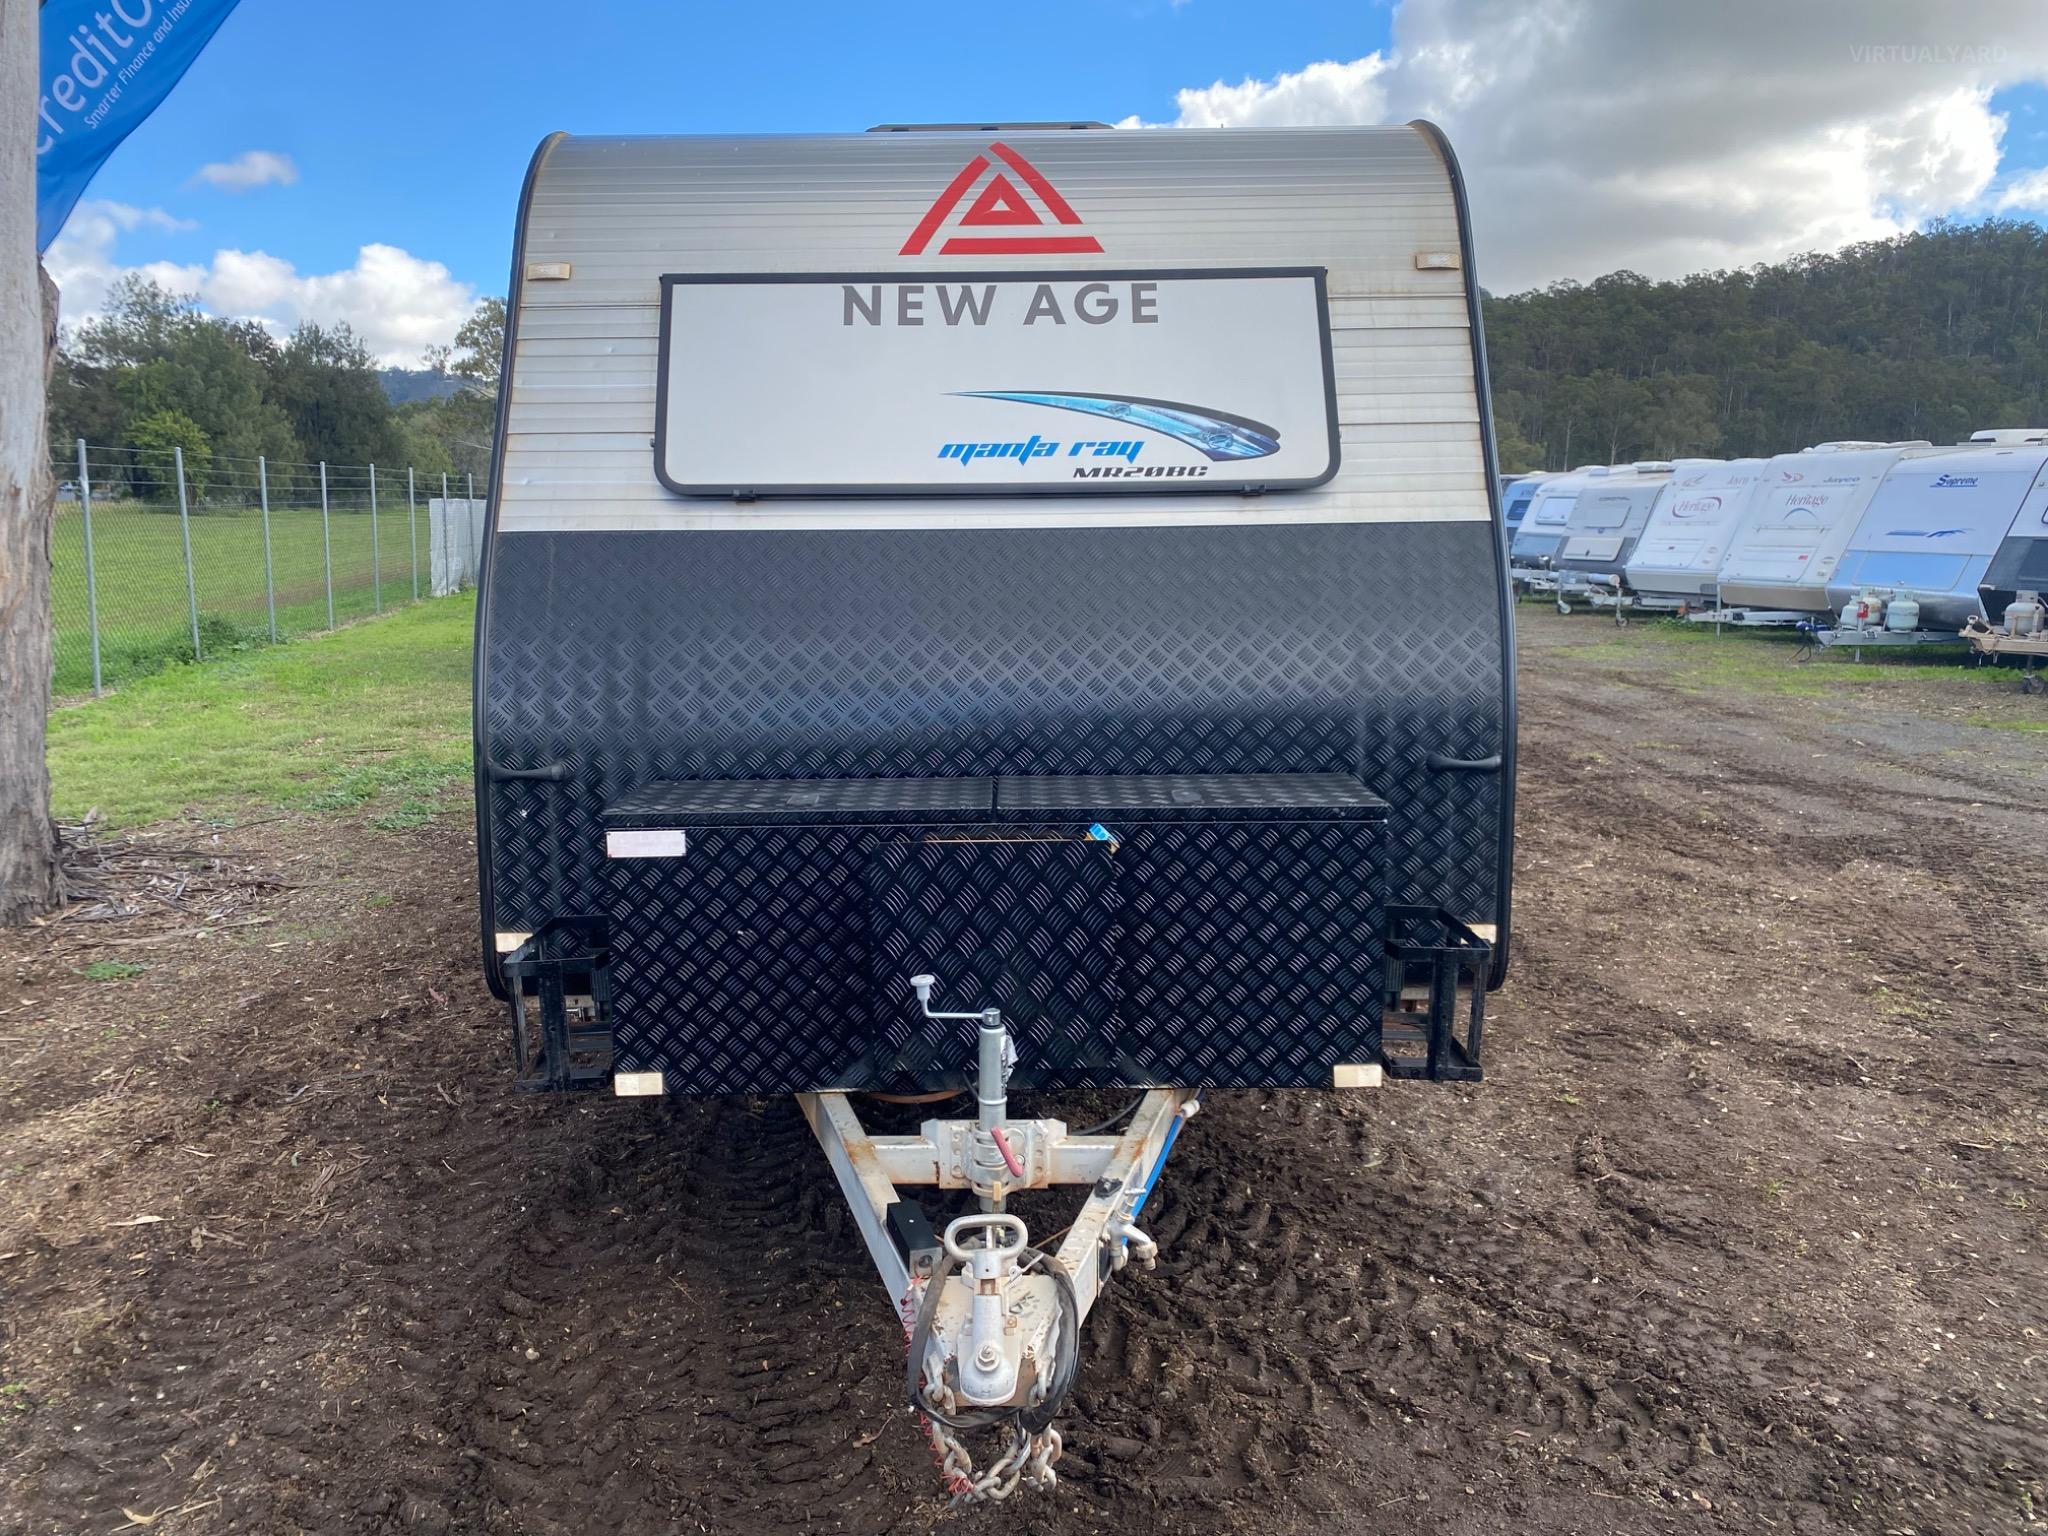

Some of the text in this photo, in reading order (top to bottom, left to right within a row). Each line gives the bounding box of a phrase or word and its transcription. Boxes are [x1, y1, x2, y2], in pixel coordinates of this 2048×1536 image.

[84, 0, 193, 129] Smarter Finance and Insu
[843, 281, 1159, 326] NEW AGE
[937, 435, 1146, 467] manta ray
[1073, 466, 1208, 478] MR20BC
[1785, 494, 1829, 507] Heritage
